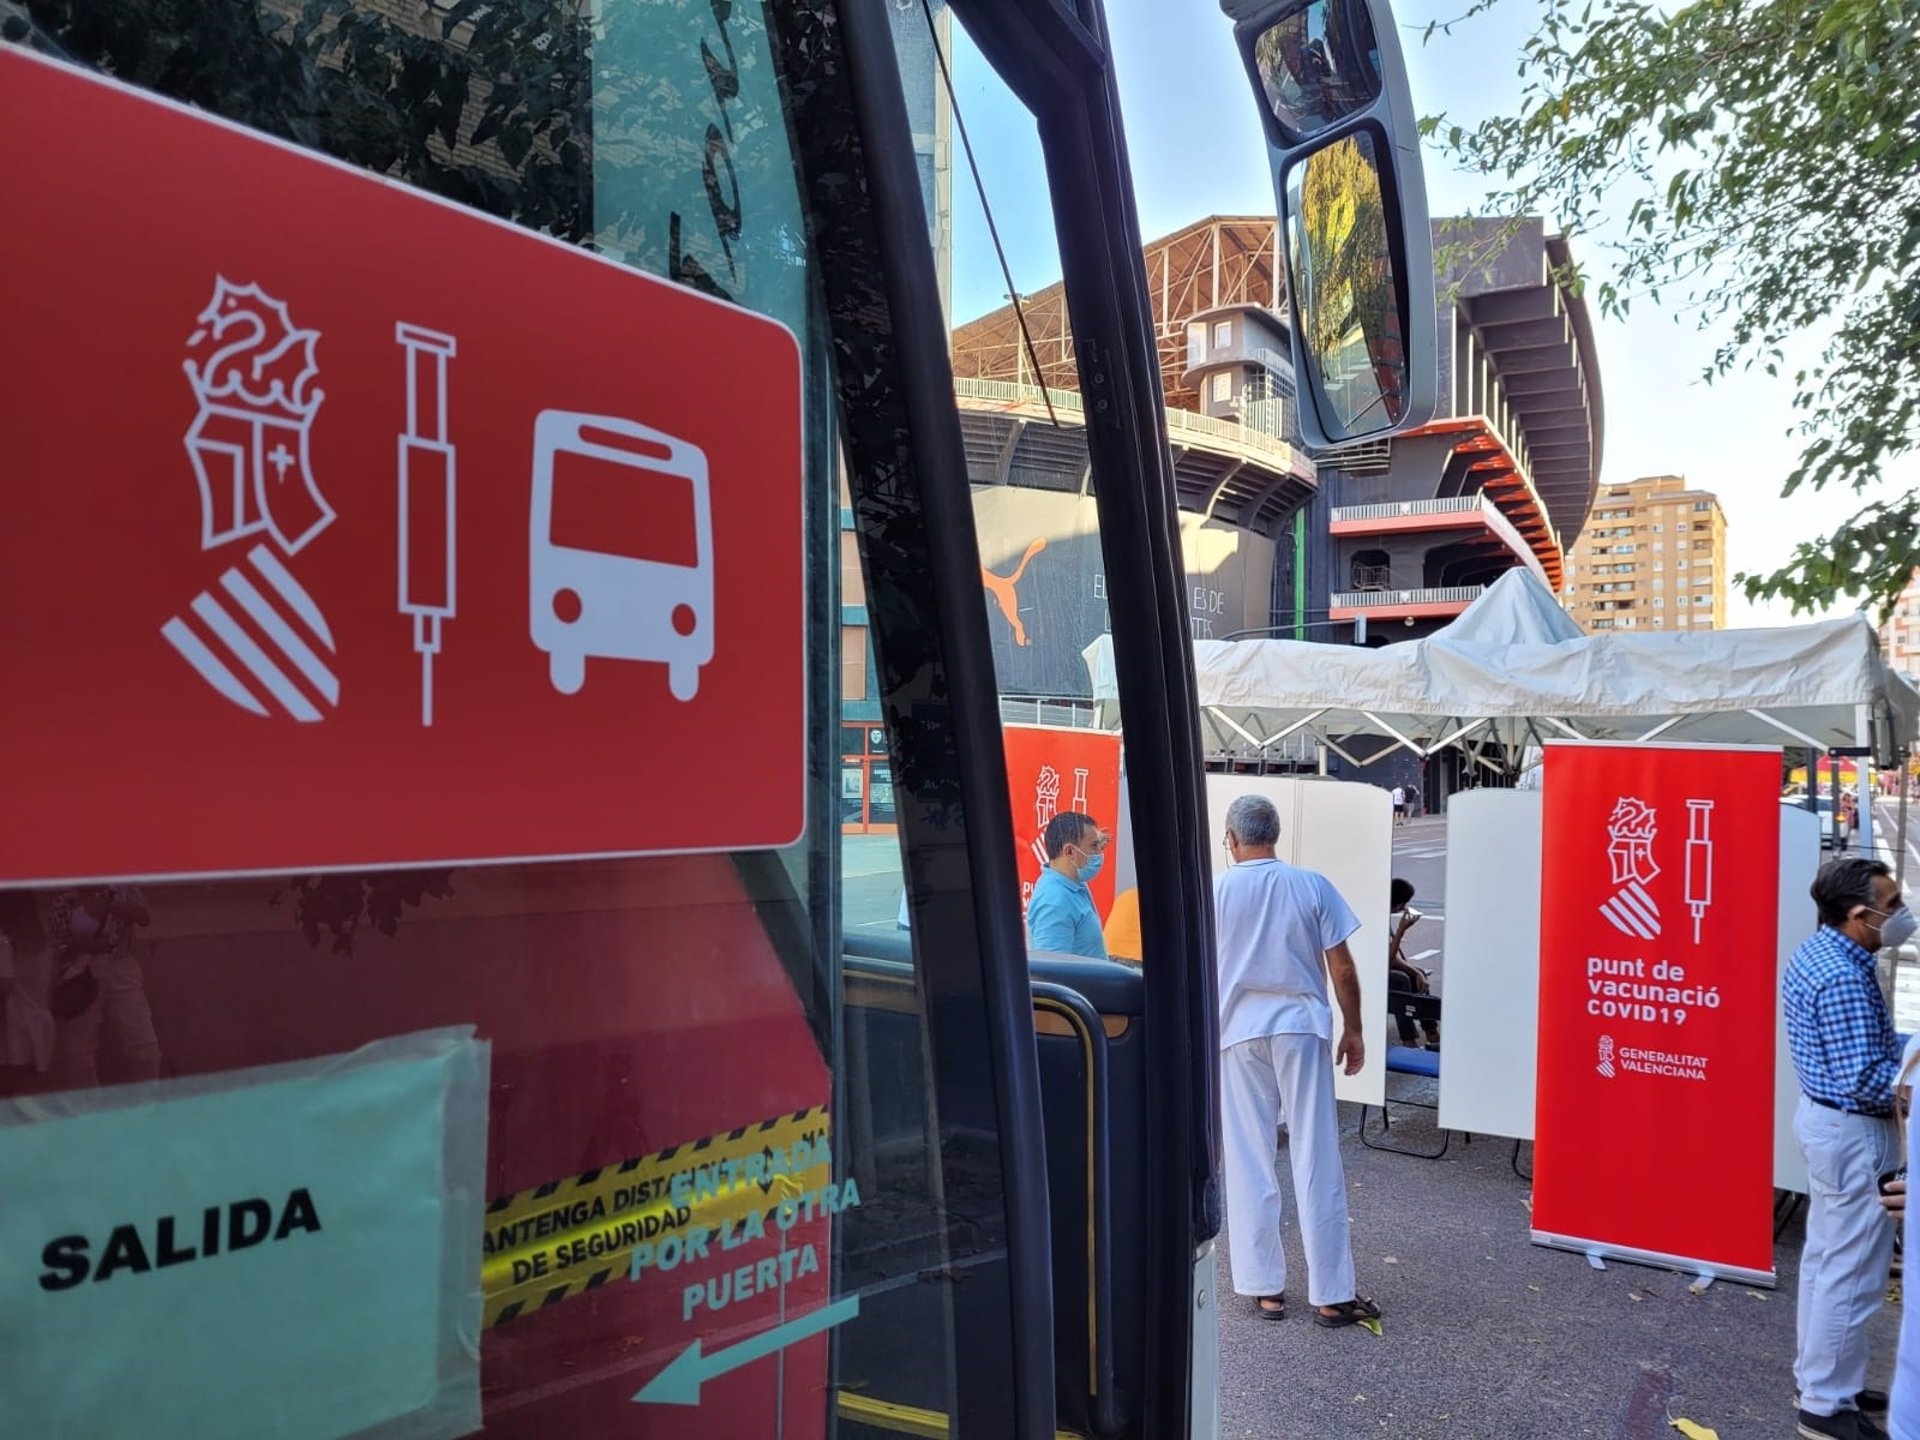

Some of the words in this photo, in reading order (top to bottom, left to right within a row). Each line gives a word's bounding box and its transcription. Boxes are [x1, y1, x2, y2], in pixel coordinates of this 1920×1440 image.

[1209, 590, 1224, 614] DE
[1587, 957, 1645, 978] punt
[1652, 960, 1685, 982] de
[1587, 978, 1721, 1008] vacunació
[1587, 999, 1687, 1025] COVID19
[1619, 1047, 1709, 1068] GENERALITAT
[1620, 1059, 1707, 1081] VALENCIANA
[669, 1135, 832, 1208] ENTRADA
[38, 1187, 322, 1292] SALIDA
[483, 1196, 605, 1254] ANTENGA
[512, 1251, 548, 1285] DE
[556, 1205, 691, 1269] SEGURIDAD
[630, 1231, 709, 1282] POR
[721, 1210, 765, 1251] LA
[775, 1178, 861, 1230] OTRA
[682, 1244, 818, 1322] PUERTA
